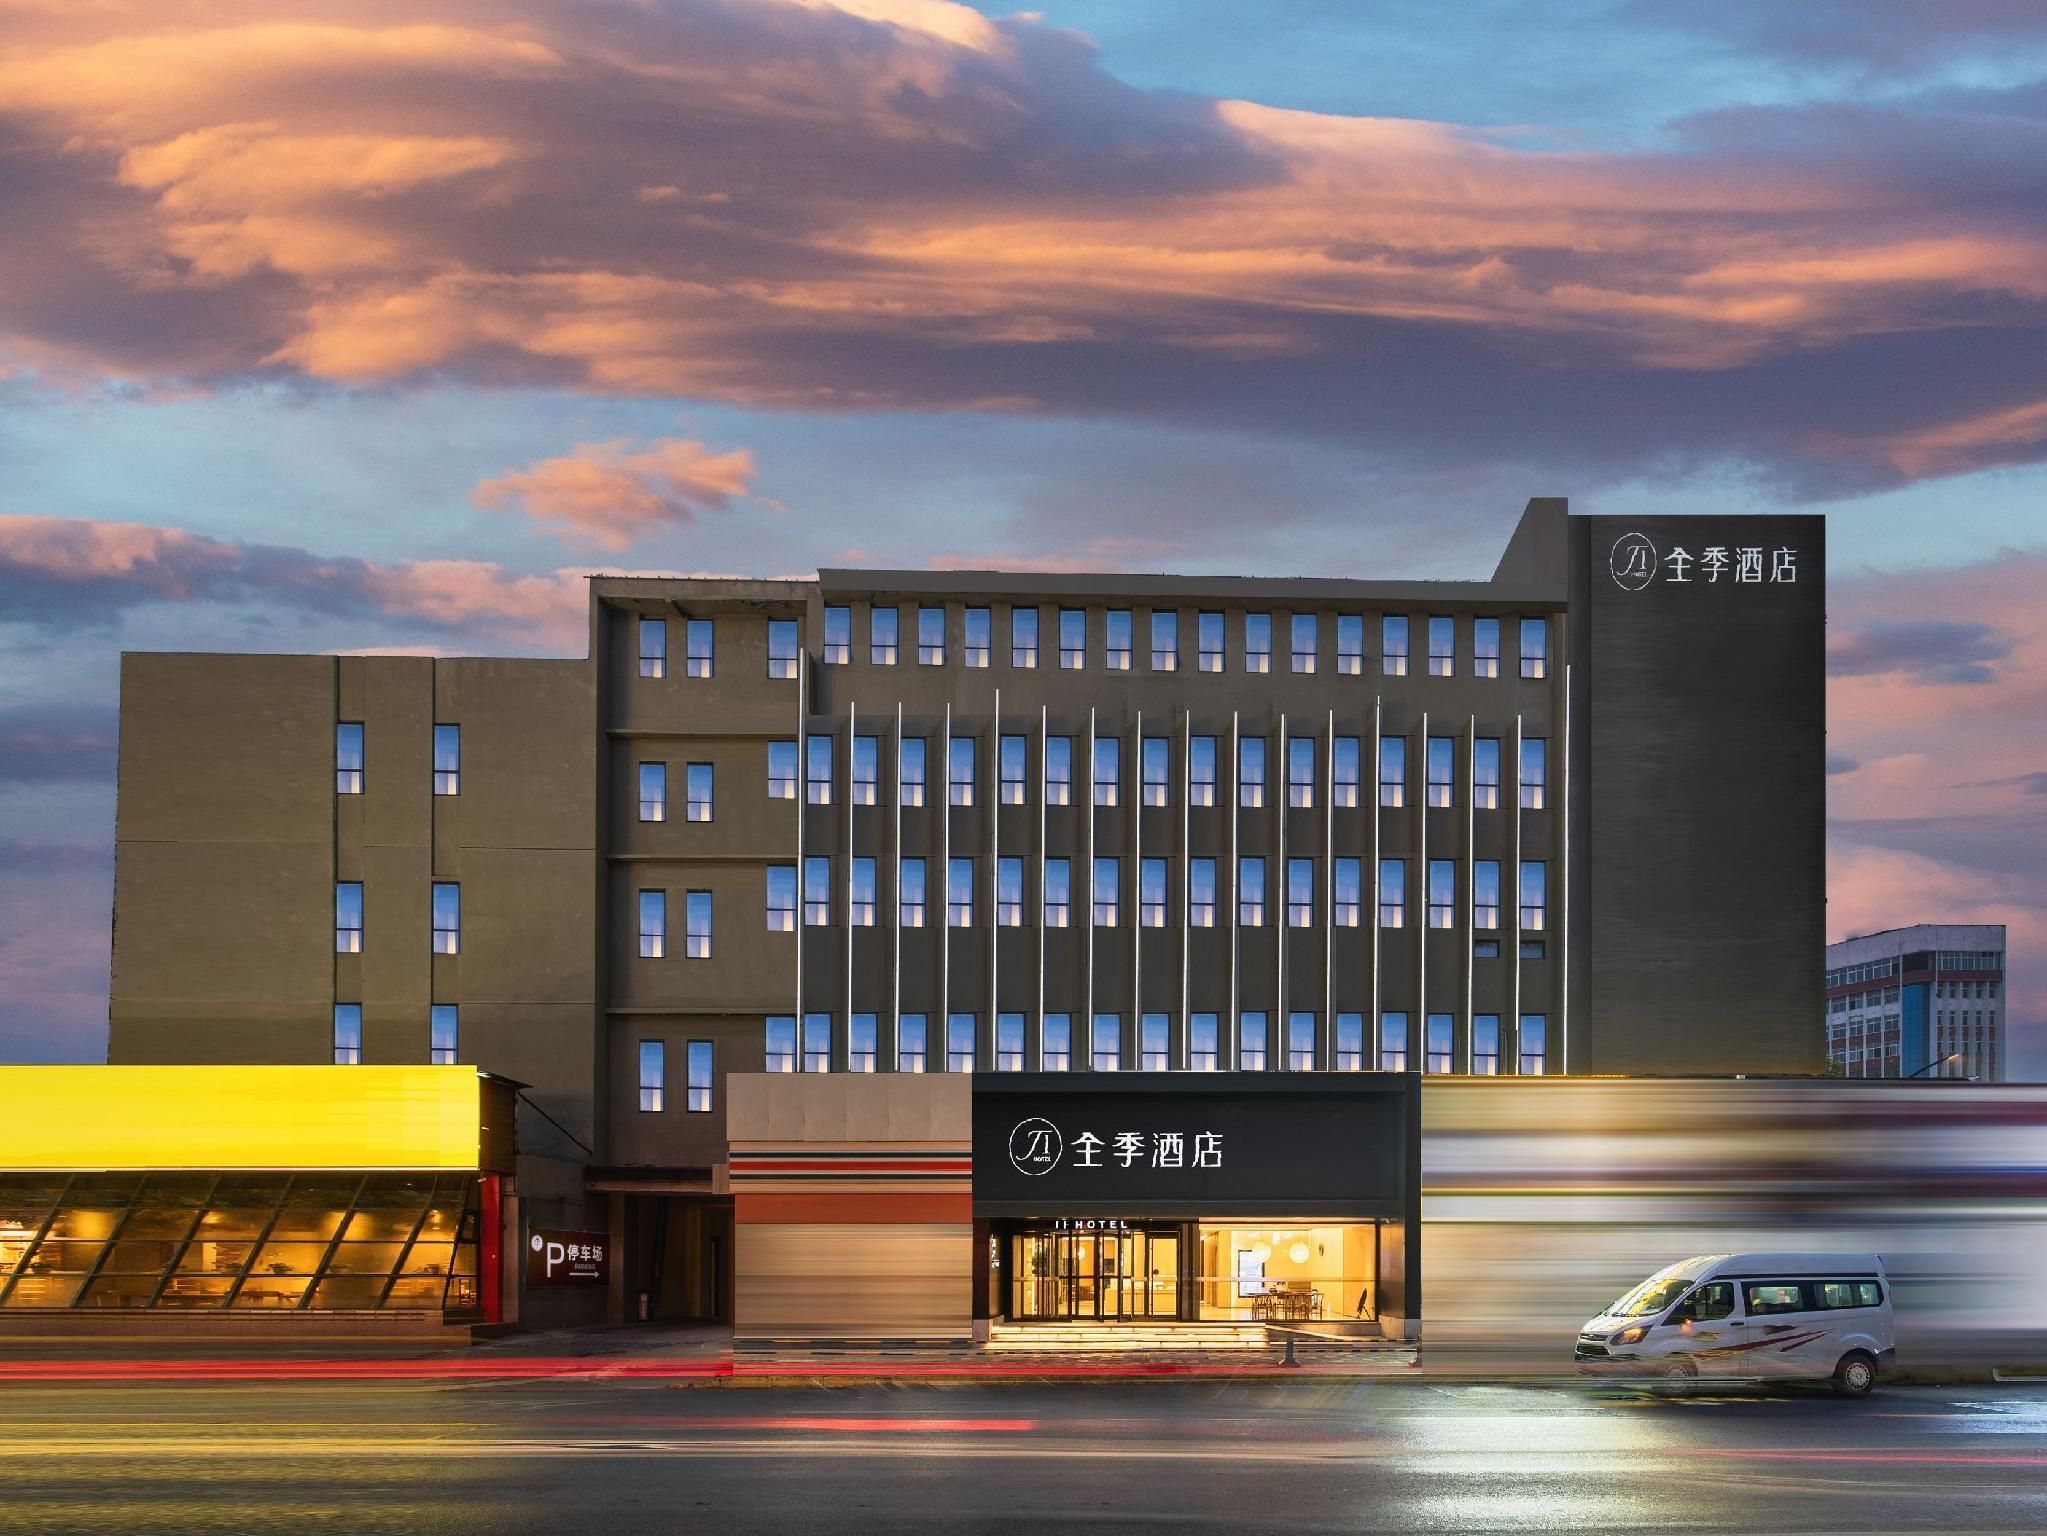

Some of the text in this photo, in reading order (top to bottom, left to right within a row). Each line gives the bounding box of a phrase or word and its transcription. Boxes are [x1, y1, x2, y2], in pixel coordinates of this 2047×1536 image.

[1664, 546, 1798, 583] 全季酒店
[1070, 1131, 1224, 1168] 全季酒店
[1075, 1220, 1128, 1229] HOTEL
[547, 1242, 603, 1278] P 停车场
